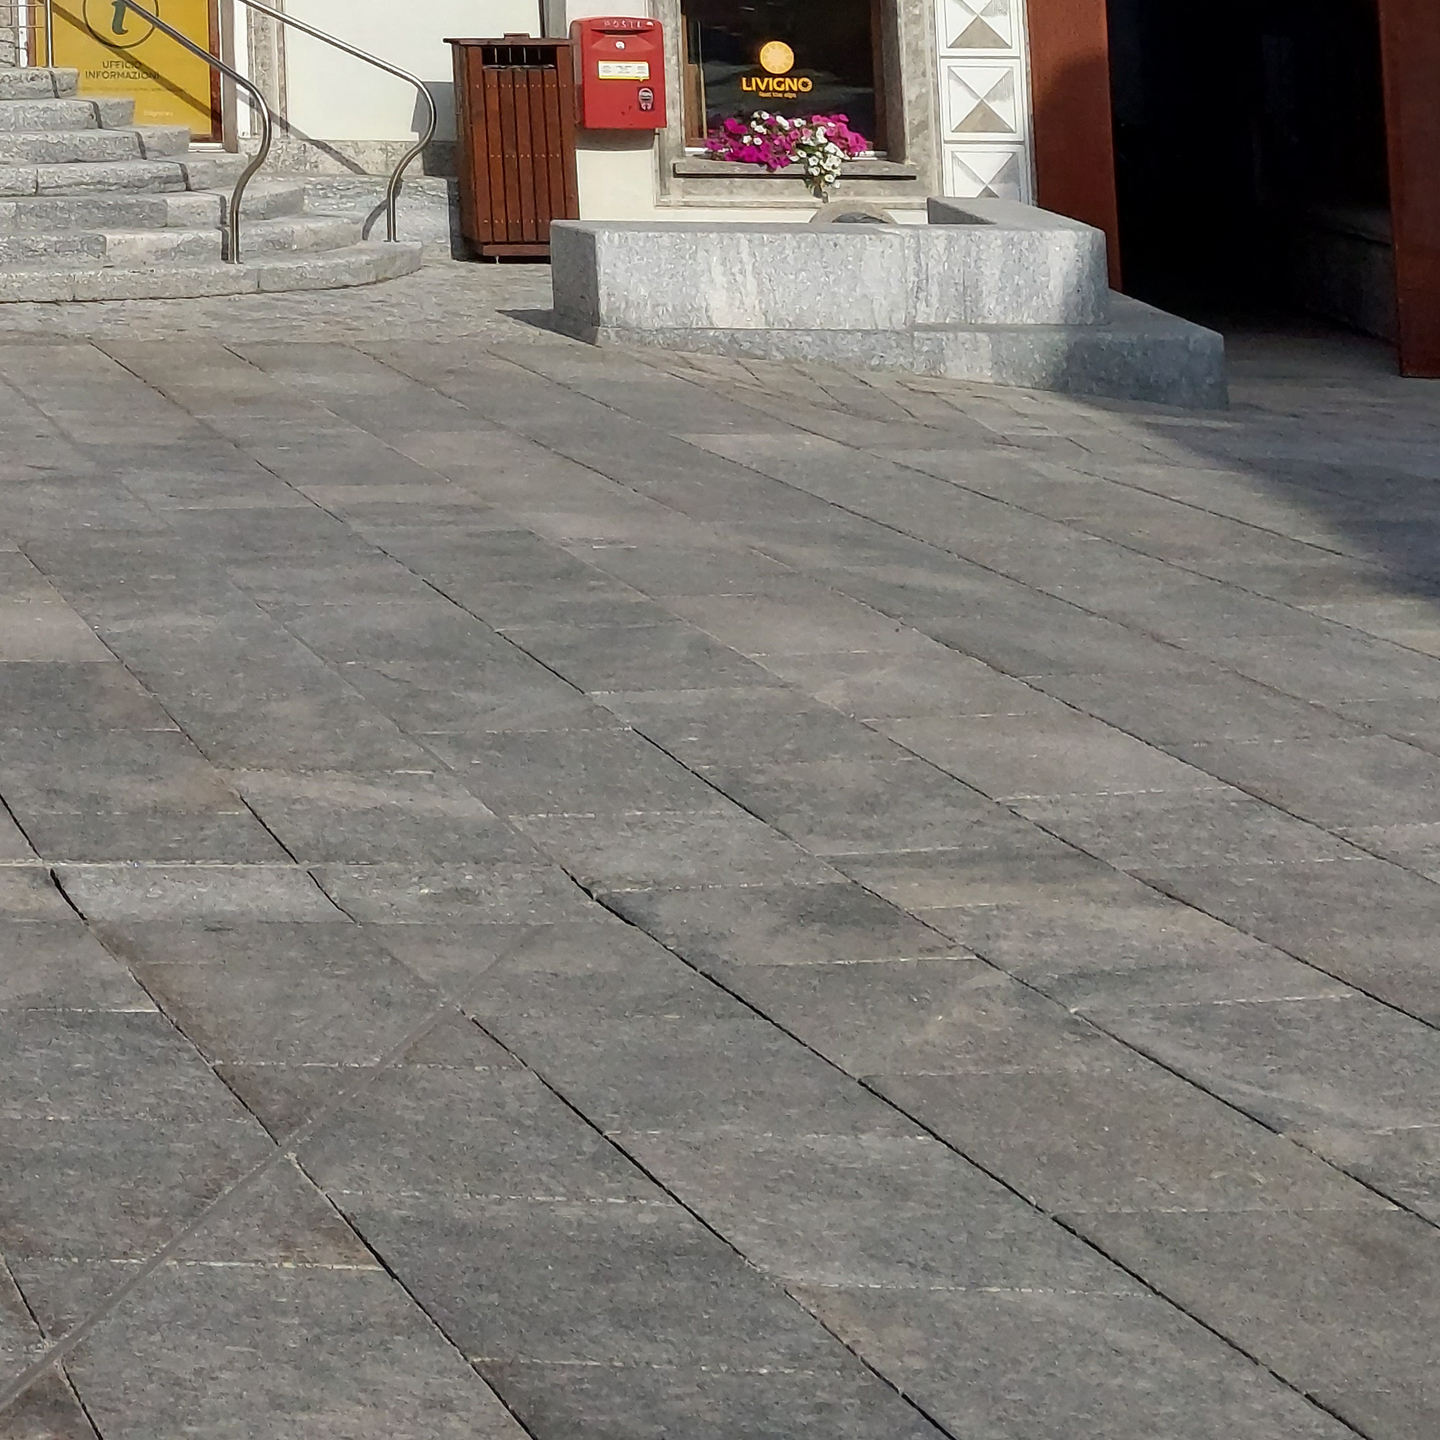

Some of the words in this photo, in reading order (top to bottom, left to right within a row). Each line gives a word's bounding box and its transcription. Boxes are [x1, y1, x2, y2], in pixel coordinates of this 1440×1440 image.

[102, 60, 142, 69] UFFICIO
[85, 70, 160, 80] INFORMAZIONI
[742, 77, 812, 92] LIVIGNO
